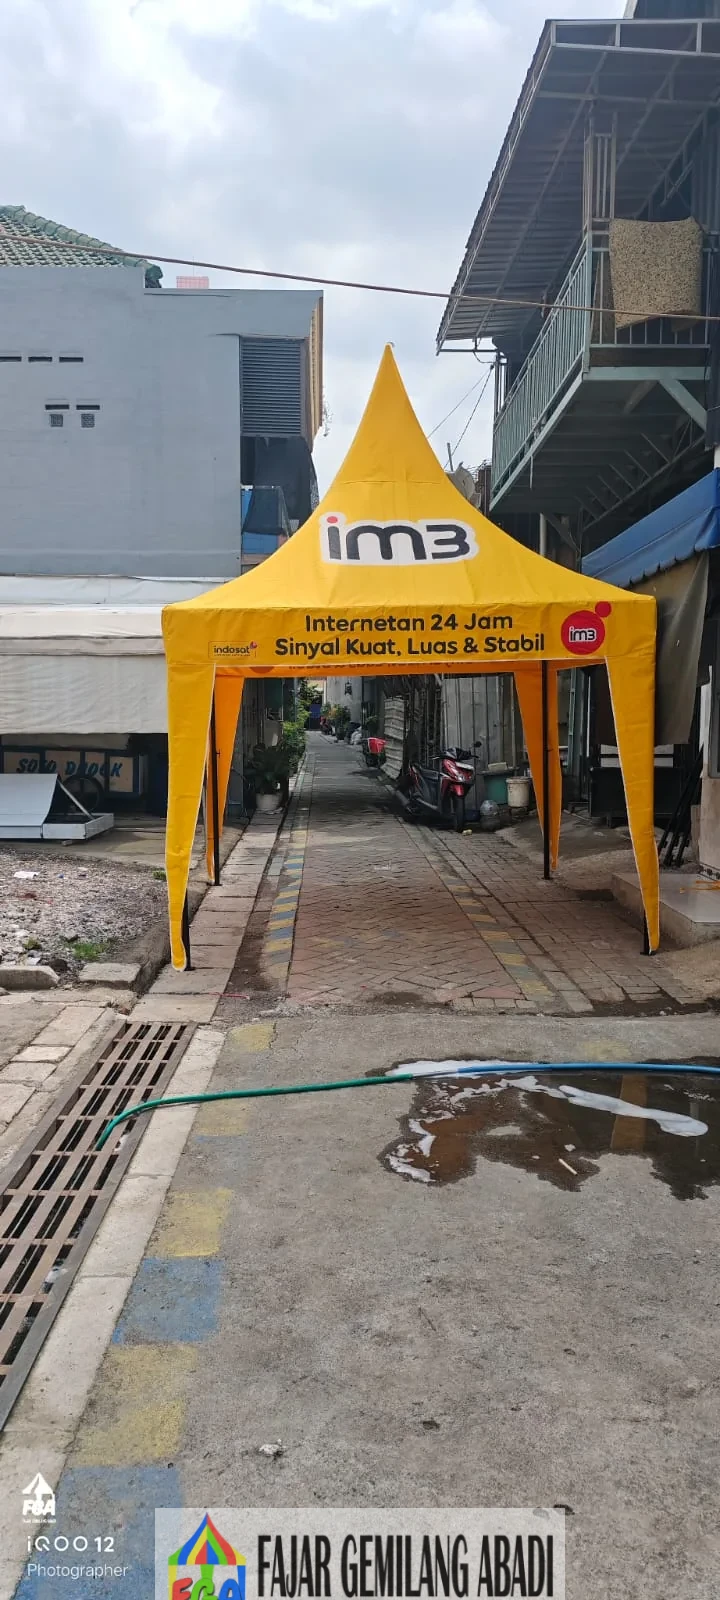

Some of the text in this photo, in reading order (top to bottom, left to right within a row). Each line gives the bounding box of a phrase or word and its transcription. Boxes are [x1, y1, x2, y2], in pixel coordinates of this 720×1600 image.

[325, 515, 471, 561] im3
[305, 612, 514, 632] Internetan 24 Jam
[569, 626, 597, 642] im3
[213, 645, 251, 654] indosat
[275, 633, 545, 660] Sinyal Kuat, Luas & Stabil
